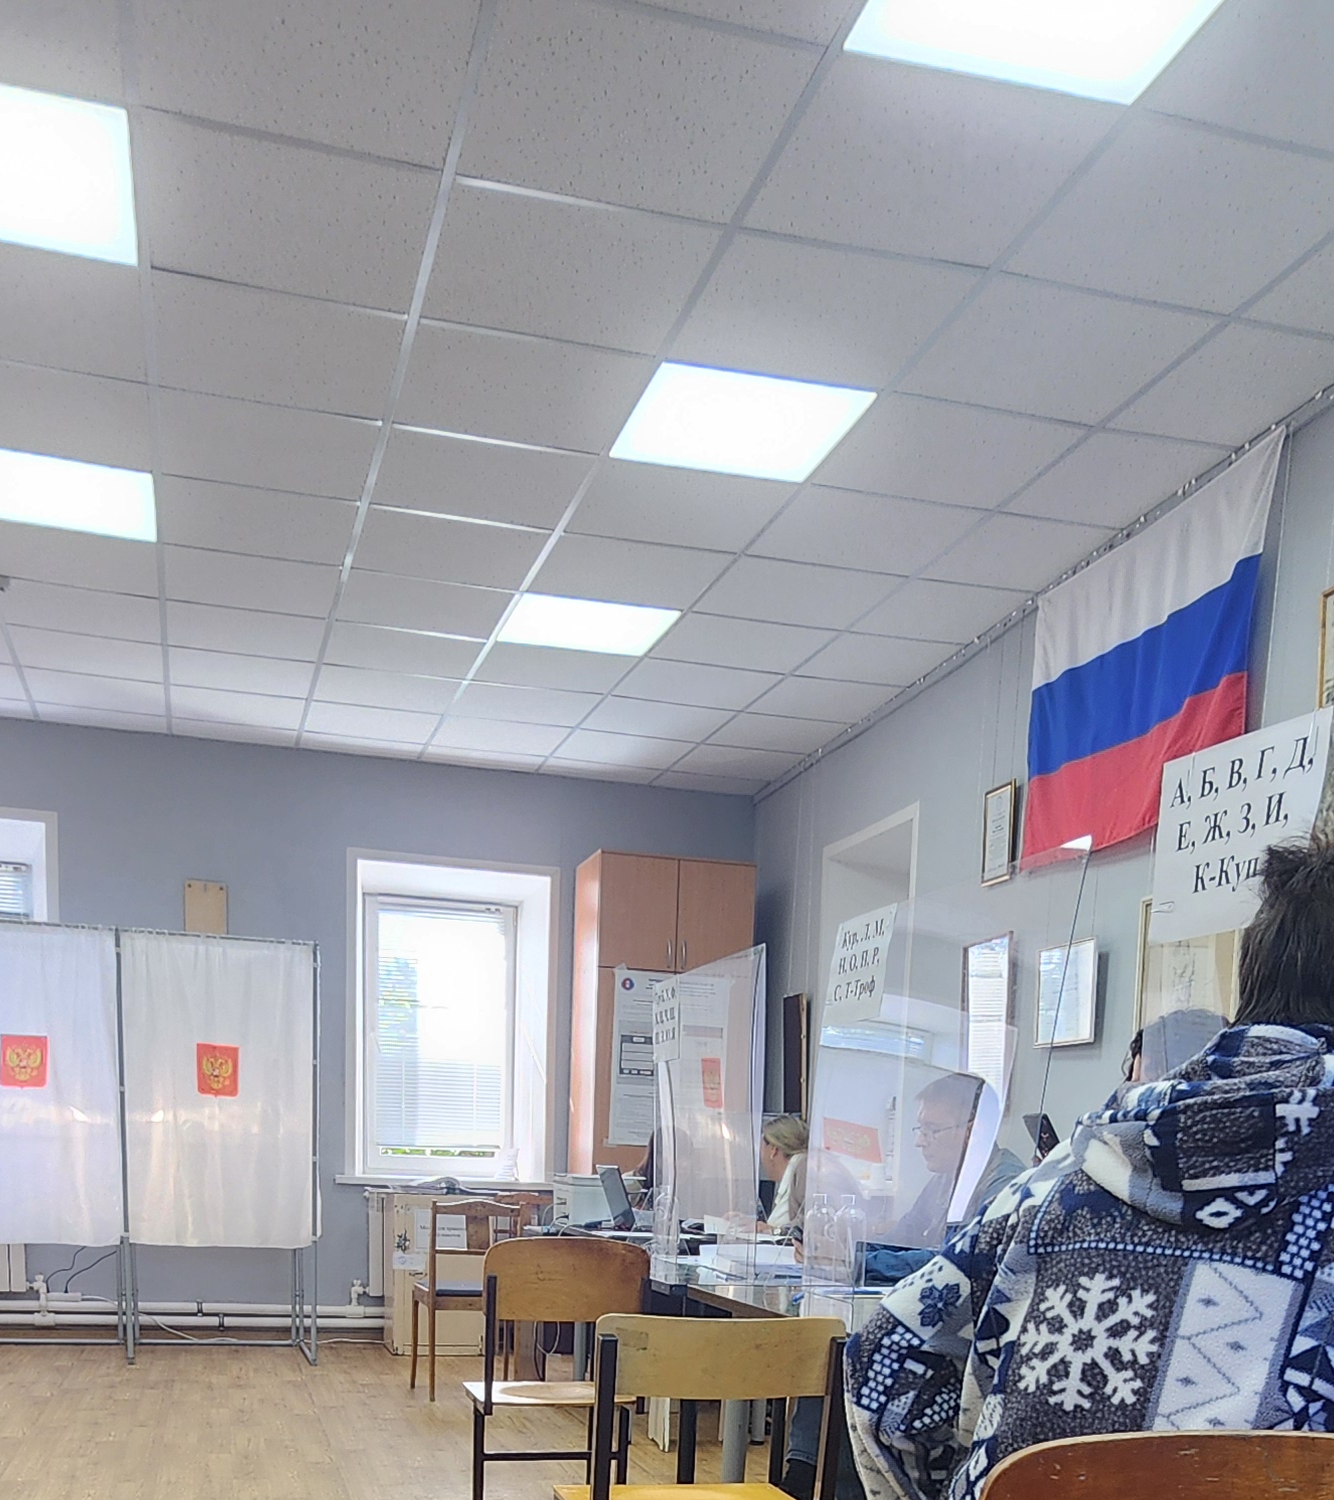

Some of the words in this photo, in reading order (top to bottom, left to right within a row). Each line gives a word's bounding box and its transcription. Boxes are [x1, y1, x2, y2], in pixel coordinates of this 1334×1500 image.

[1170, 778, 1192, 809] А,
[1198, 766, 1219, 801] Б,
[1226, 757, 1248, 792] В,
[1254, 746, 1278, 783] Г,
[1283, 737, 1313, 779] Д,
[1176, 821, 1195, 854] Е,
[1203, 810, 1230, 844] Ж,
[1237, 802, 1256, 838] З,
[1263, 791, 1289, 828] И,
